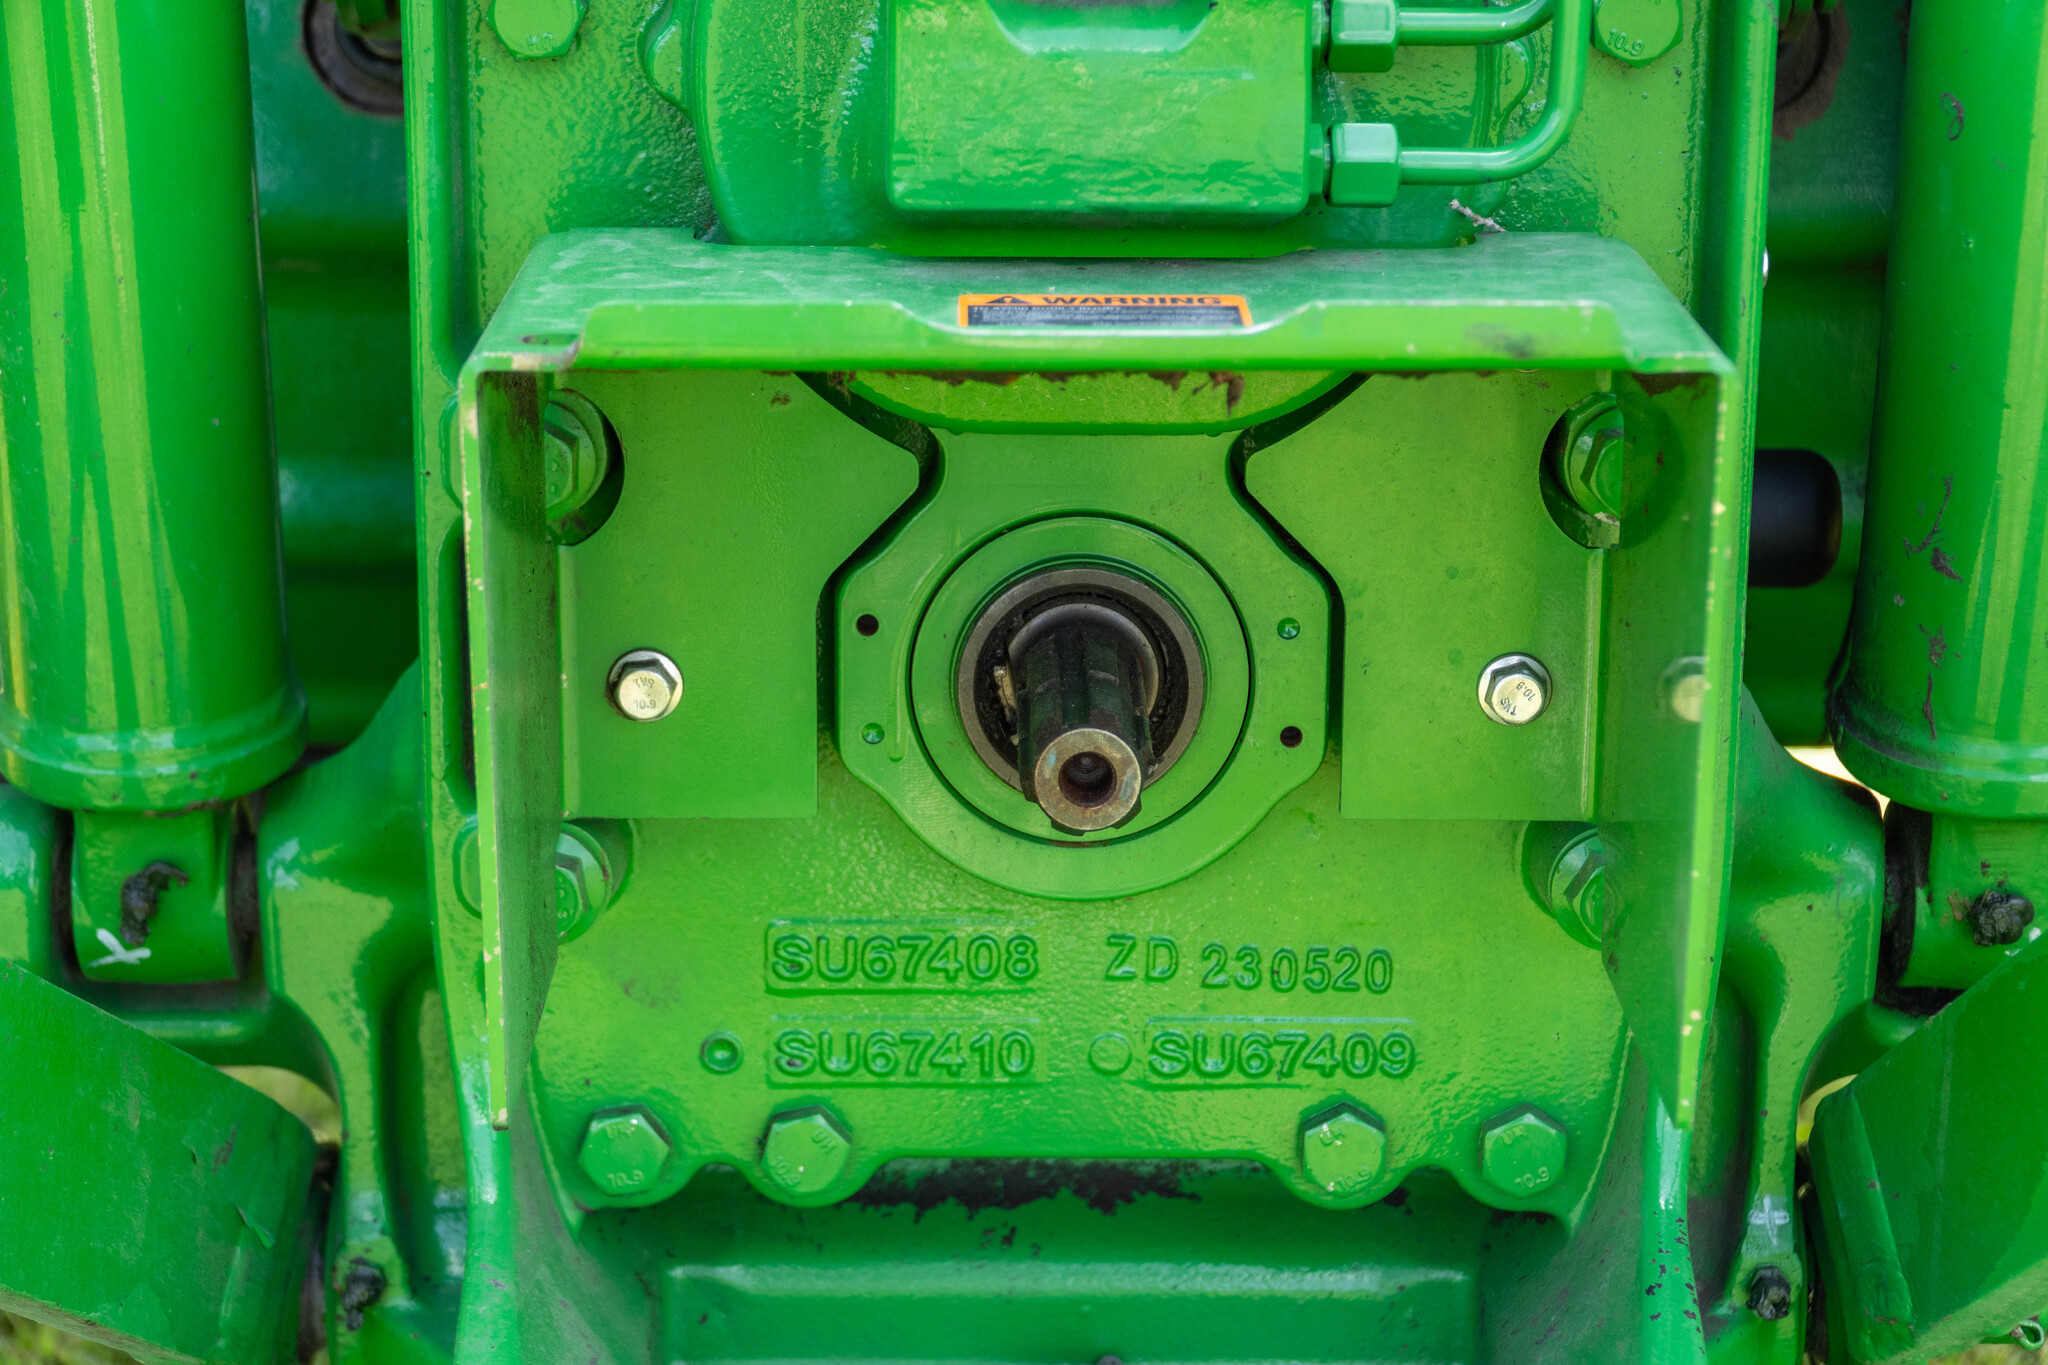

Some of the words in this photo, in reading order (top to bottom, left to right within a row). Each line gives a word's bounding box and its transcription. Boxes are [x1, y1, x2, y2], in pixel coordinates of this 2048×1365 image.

[1607, 28, 1645, 57] 10.9
[1041, 296, 1222, 305] WARNING
[632, 676, 656, 689] TVS
[633, 699, 657, 710] 10.9
[771, 933, 1040, 983] SU67408
[1200, 941, 1394, 995] 230520
[774, 1028, 1036, 1078] SU67410
[1149, 1029, 1416, 1080] SU67409
[1513, 1166, 1550, 1190] 10.9
